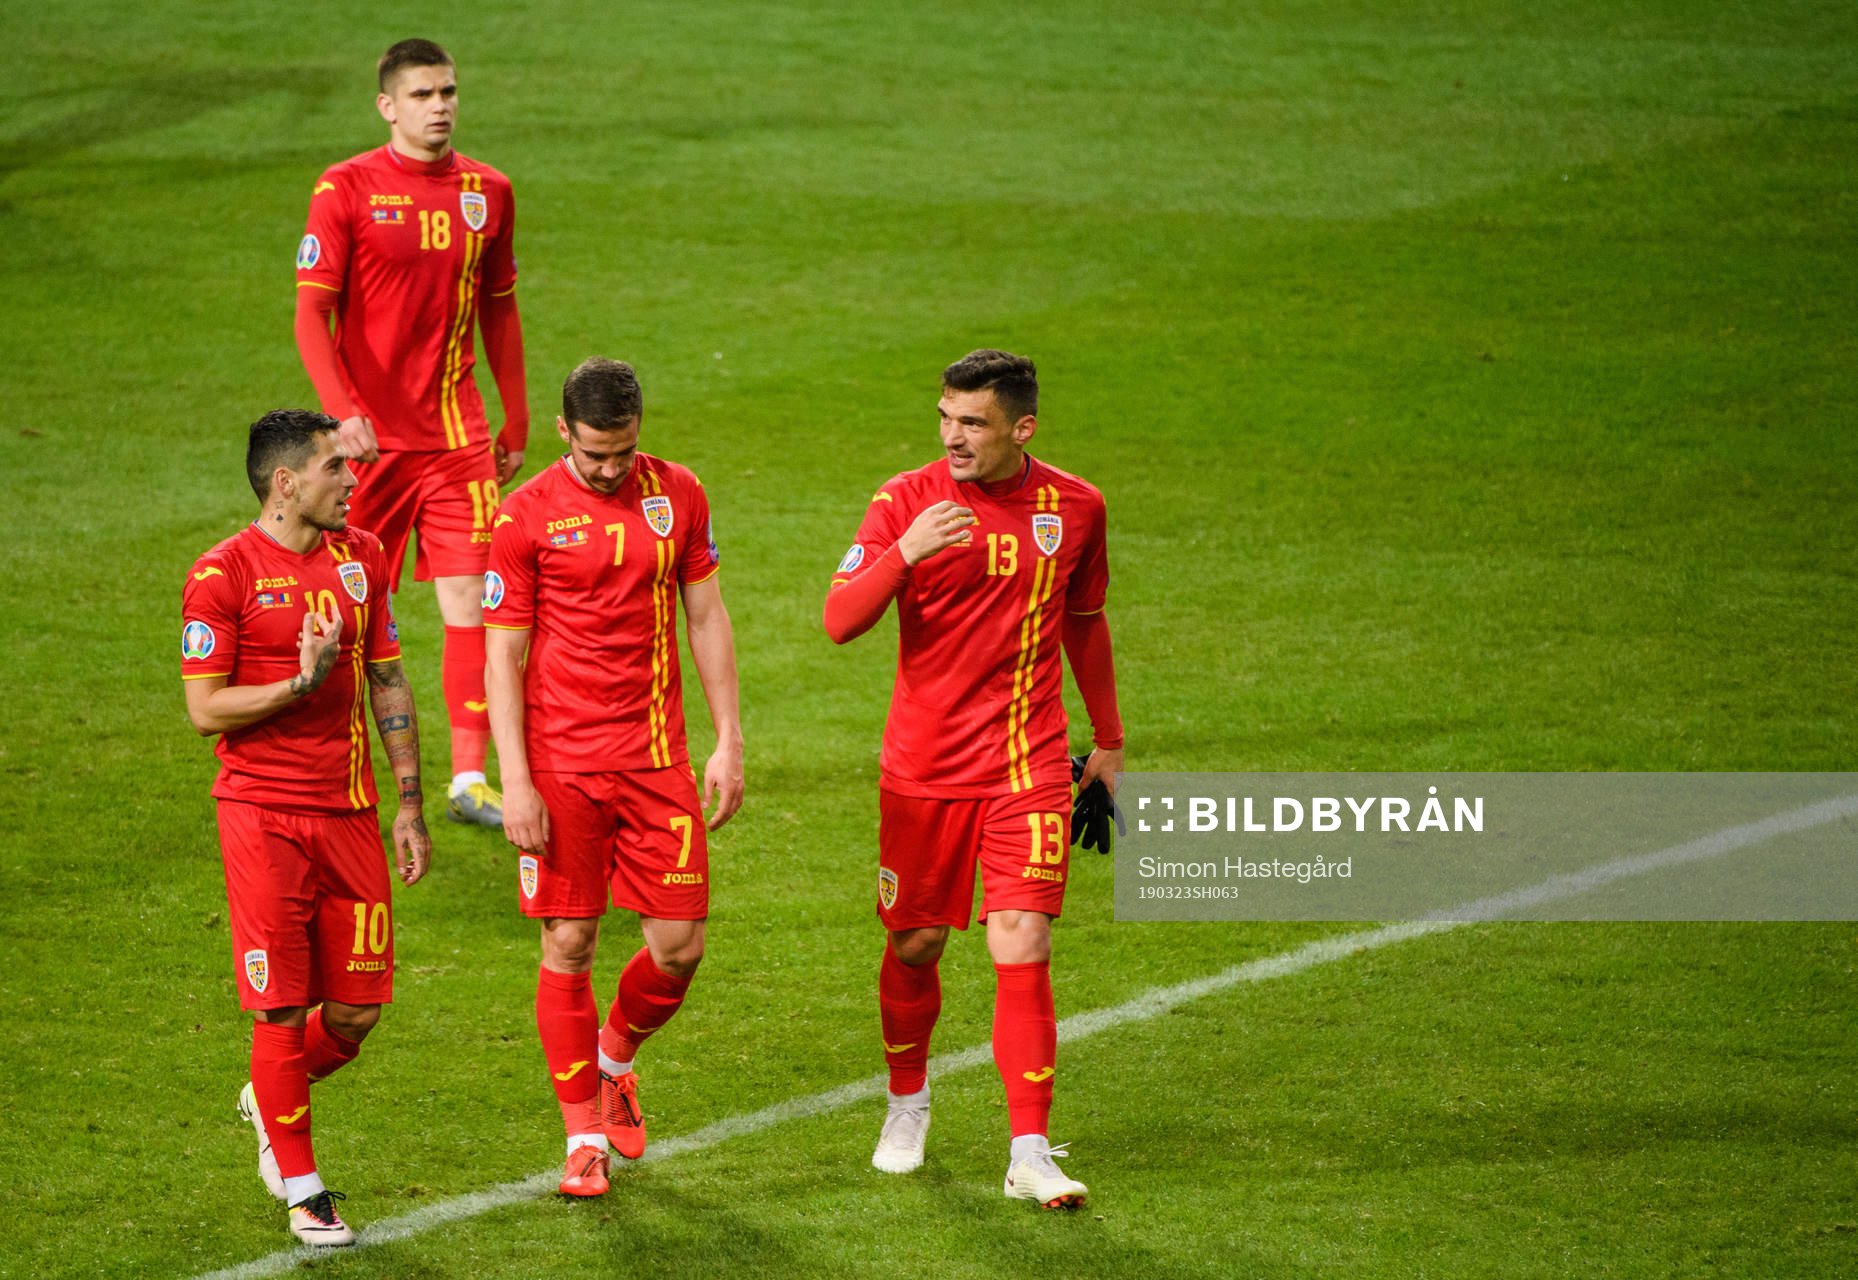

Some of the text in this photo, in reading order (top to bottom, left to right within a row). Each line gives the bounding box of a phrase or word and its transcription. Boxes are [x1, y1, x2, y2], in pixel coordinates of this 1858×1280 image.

[418, 210, 451, 250] 18
[467, 479, 500, 529] 18
[604, 522, 625, 566] 7
[986, 533, 1019, 576] 13
[669, 815, 693, 868] 7
[1027, 812, 1064, 865] 13
[352, 902, 389, 955] 10
